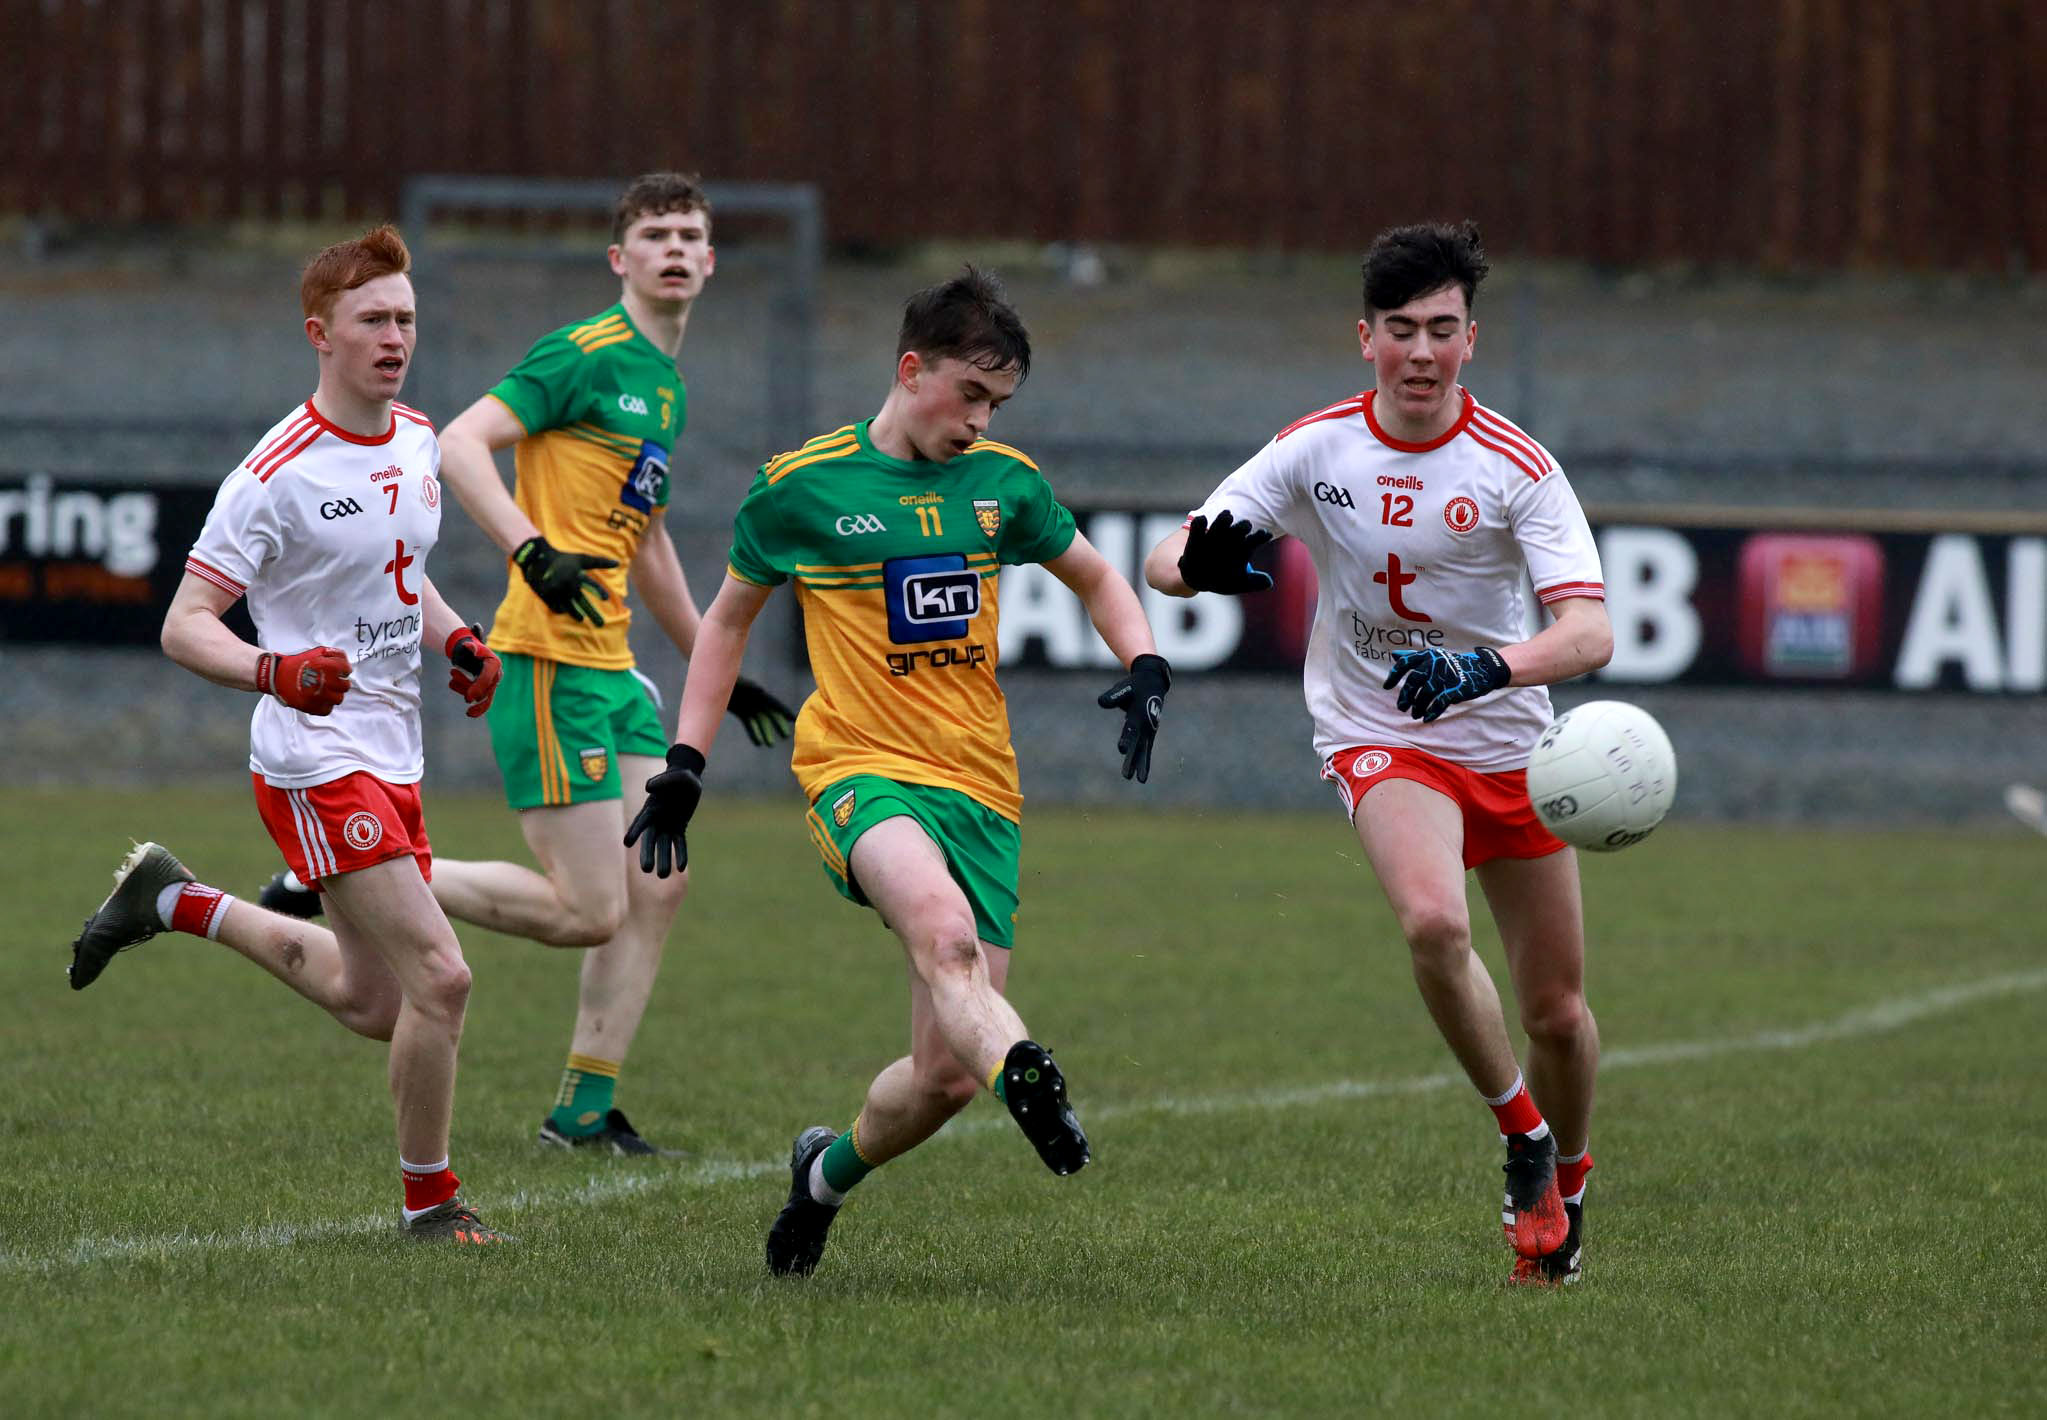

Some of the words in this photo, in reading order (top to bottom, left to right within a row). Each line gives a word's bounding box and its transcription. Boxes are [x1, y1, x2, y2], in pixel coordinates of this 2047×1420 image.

[383, 483, 399, 516] 7
[1381, 492, 1415, 528] 12
[915, 506, 944, 537] 11
[913, 582, 974, 616] kn
[354, 611, 421, 652] tyrone
[1352, 610, 1444, 647] tyrone
[886, 644, 986, 677] group
